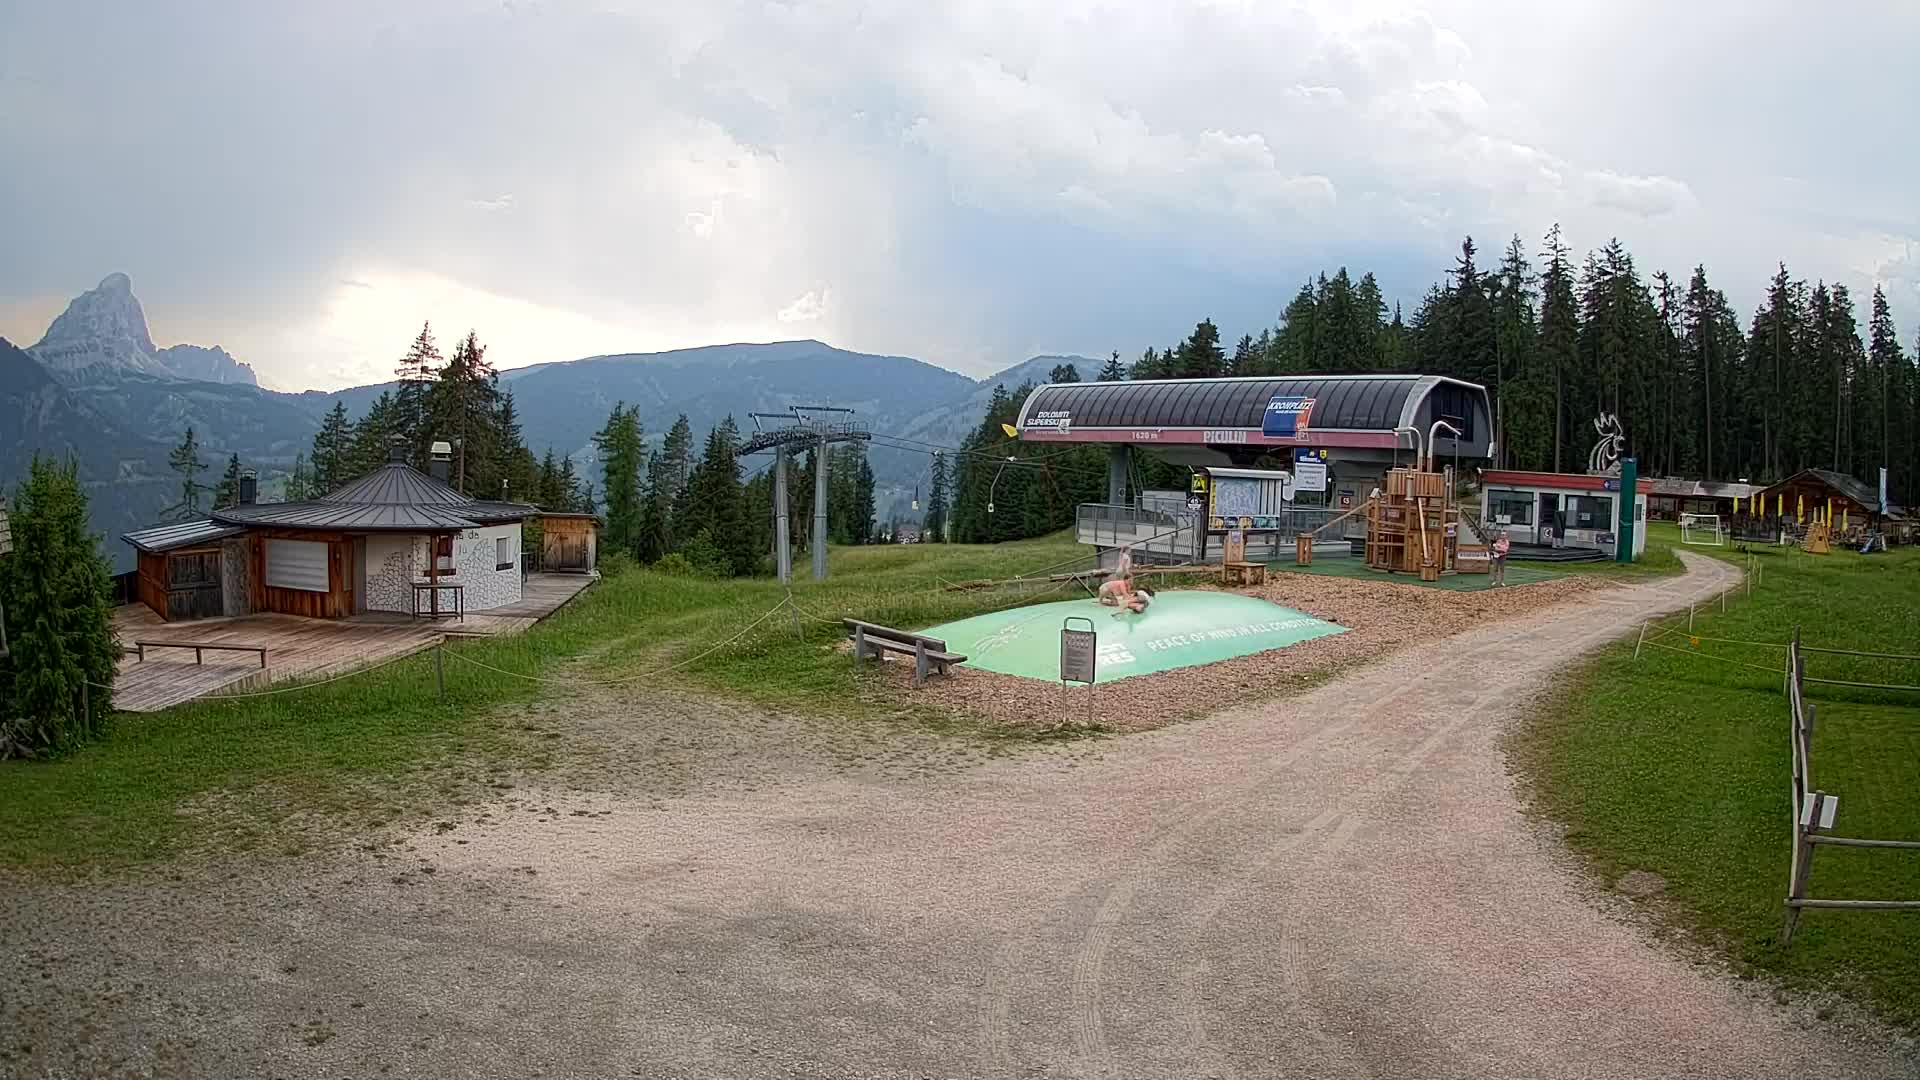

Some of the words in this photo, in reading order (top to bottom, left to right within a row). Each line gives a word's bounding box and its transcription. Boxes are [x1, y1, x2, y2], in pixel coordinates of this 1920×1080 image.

[1203, 430, 1247, 444] PICULIN
[1146, 635, 1191, 652] PEACE
[1190, 632, 1206, 642] OF
